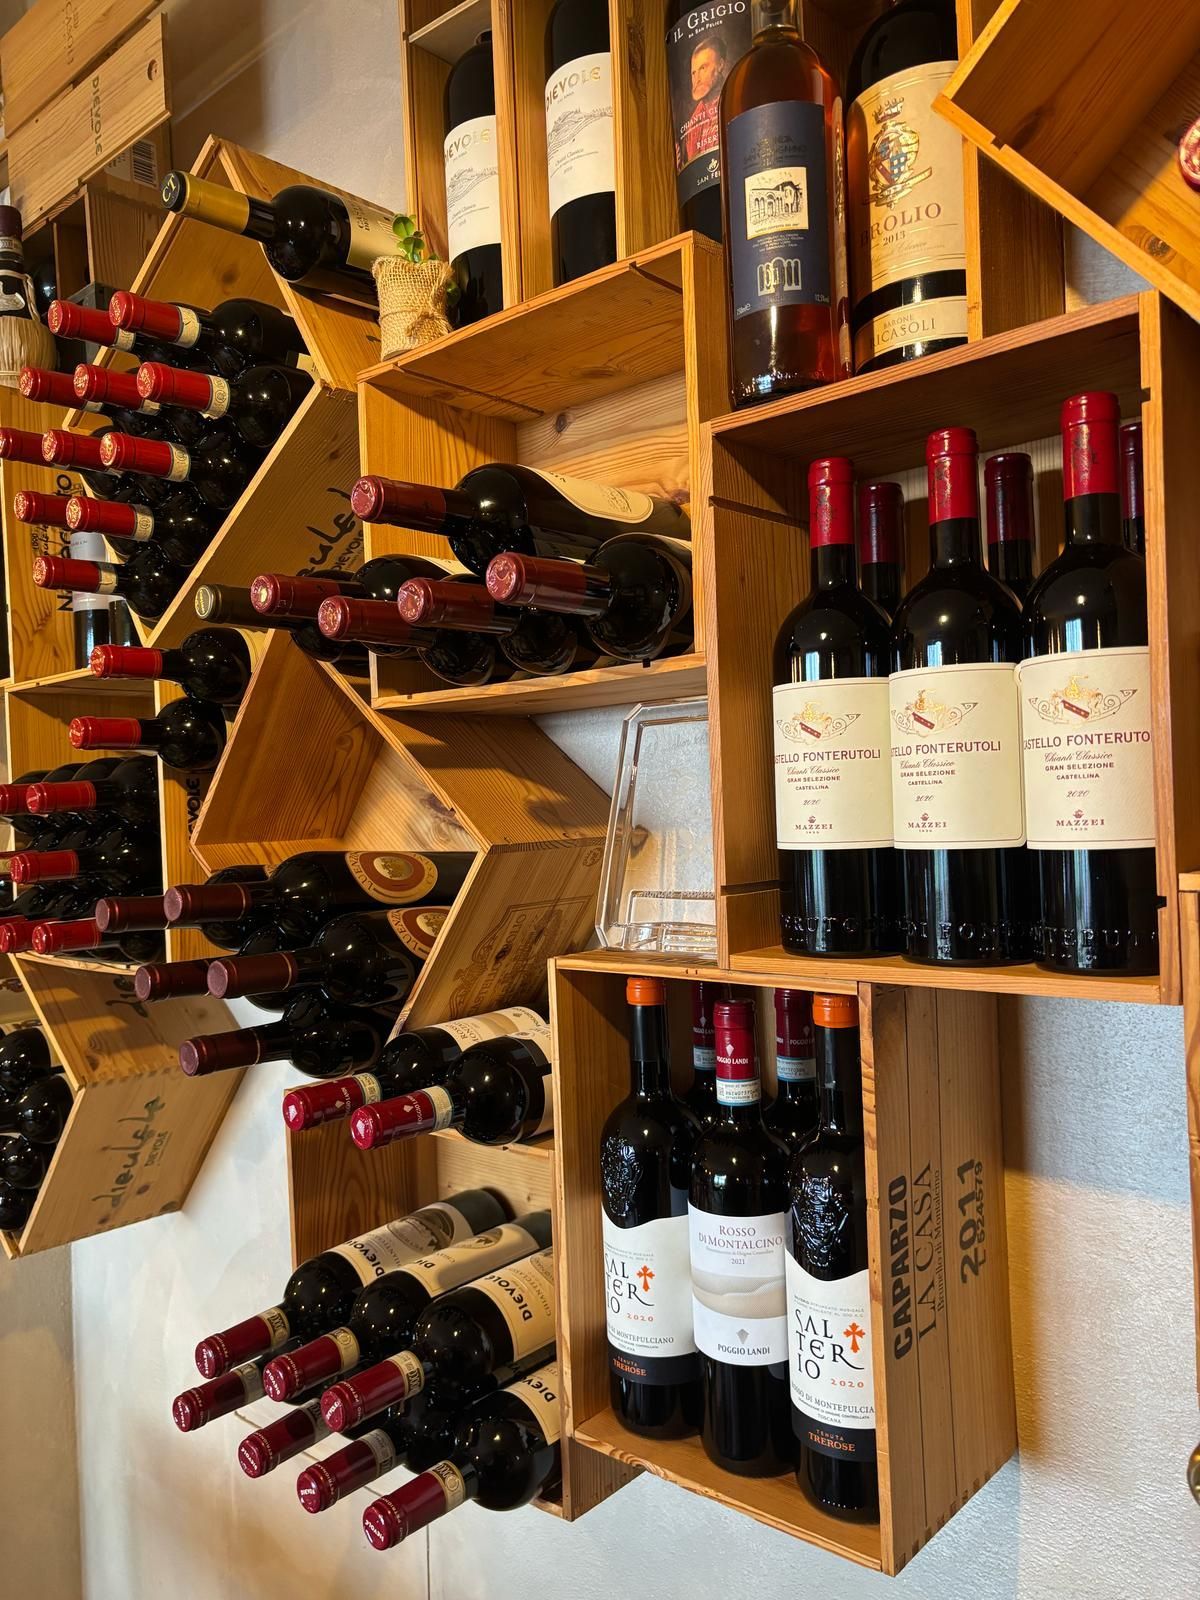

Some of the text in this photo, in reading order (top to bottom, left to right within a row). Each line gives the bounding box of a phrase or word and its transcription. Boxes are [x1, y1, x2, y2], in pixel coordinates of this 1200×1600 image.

[674, 1, 745, 43] IL GRIGIO
[696, 134, 719, 149] RISER
[882, 230, 906, 246] 2013
[884, 314, 914, 329] BARONE
[1066, 731, 1151, 746] FONTERUTO
[803, 749, 881, 762] FONTERUTOLI
[916, 741, 1001, 755] FONTERUTOLI
[922, 758, 955, 768] Classico
[1044, 750, 1113, 763] Chianti Classico
[809, 765, 840, 774] Classico
[915, 769, 956, 777] SELEZIONE
[1067, 762, 1115, 770] SELEZIONE
[803, 775, 841, 783] SELEZIONE
[915, 794, 934, 802] 2020
[1066, 790, 1089, 798] 2020
[908, 821, 947, 829] MAZZEI
[1056, 818, 1105, 827] MAZZEI
[933, 1169, 943, 1240] Montalcino
[957, 1159, 980, 1284] 2011
[719, 1225, 756, 1237] ROSSO
[698, 1232, 783, 1249] DI MONTALCINO
[913, 1160, 937, 1340] LA CASA
[889, 1175, 913, 1360] CAPARZO
[626, 1312, 654, 1323] 2020
[795, 1309, 834, 1340] SAL
[617, 1329, 674, 1344] MONTEPULCIANO
[718, 1344, 770, 1356] POGGIO LANDI
[795, 1331, 865, 1370] TER
[613, 1358, 648, 1376] TREROSE
[798, 1353, 820, 1380] IO
[266, 1369, 280, 1395] DIEVOLE
[831, 1378, 865, 1389] 2020
[805, 1393, 813, 1402] DI
[814, 1397, 875, 1414] MONTEPULCIA
[818, 1413, 842, 1424] TOSCANA
[808, 1431, 856, 1452] TREROSE
[816, 1429, 844, 1441] TENUTA
[241, 1447, 258, 1471] DIEVOLE
